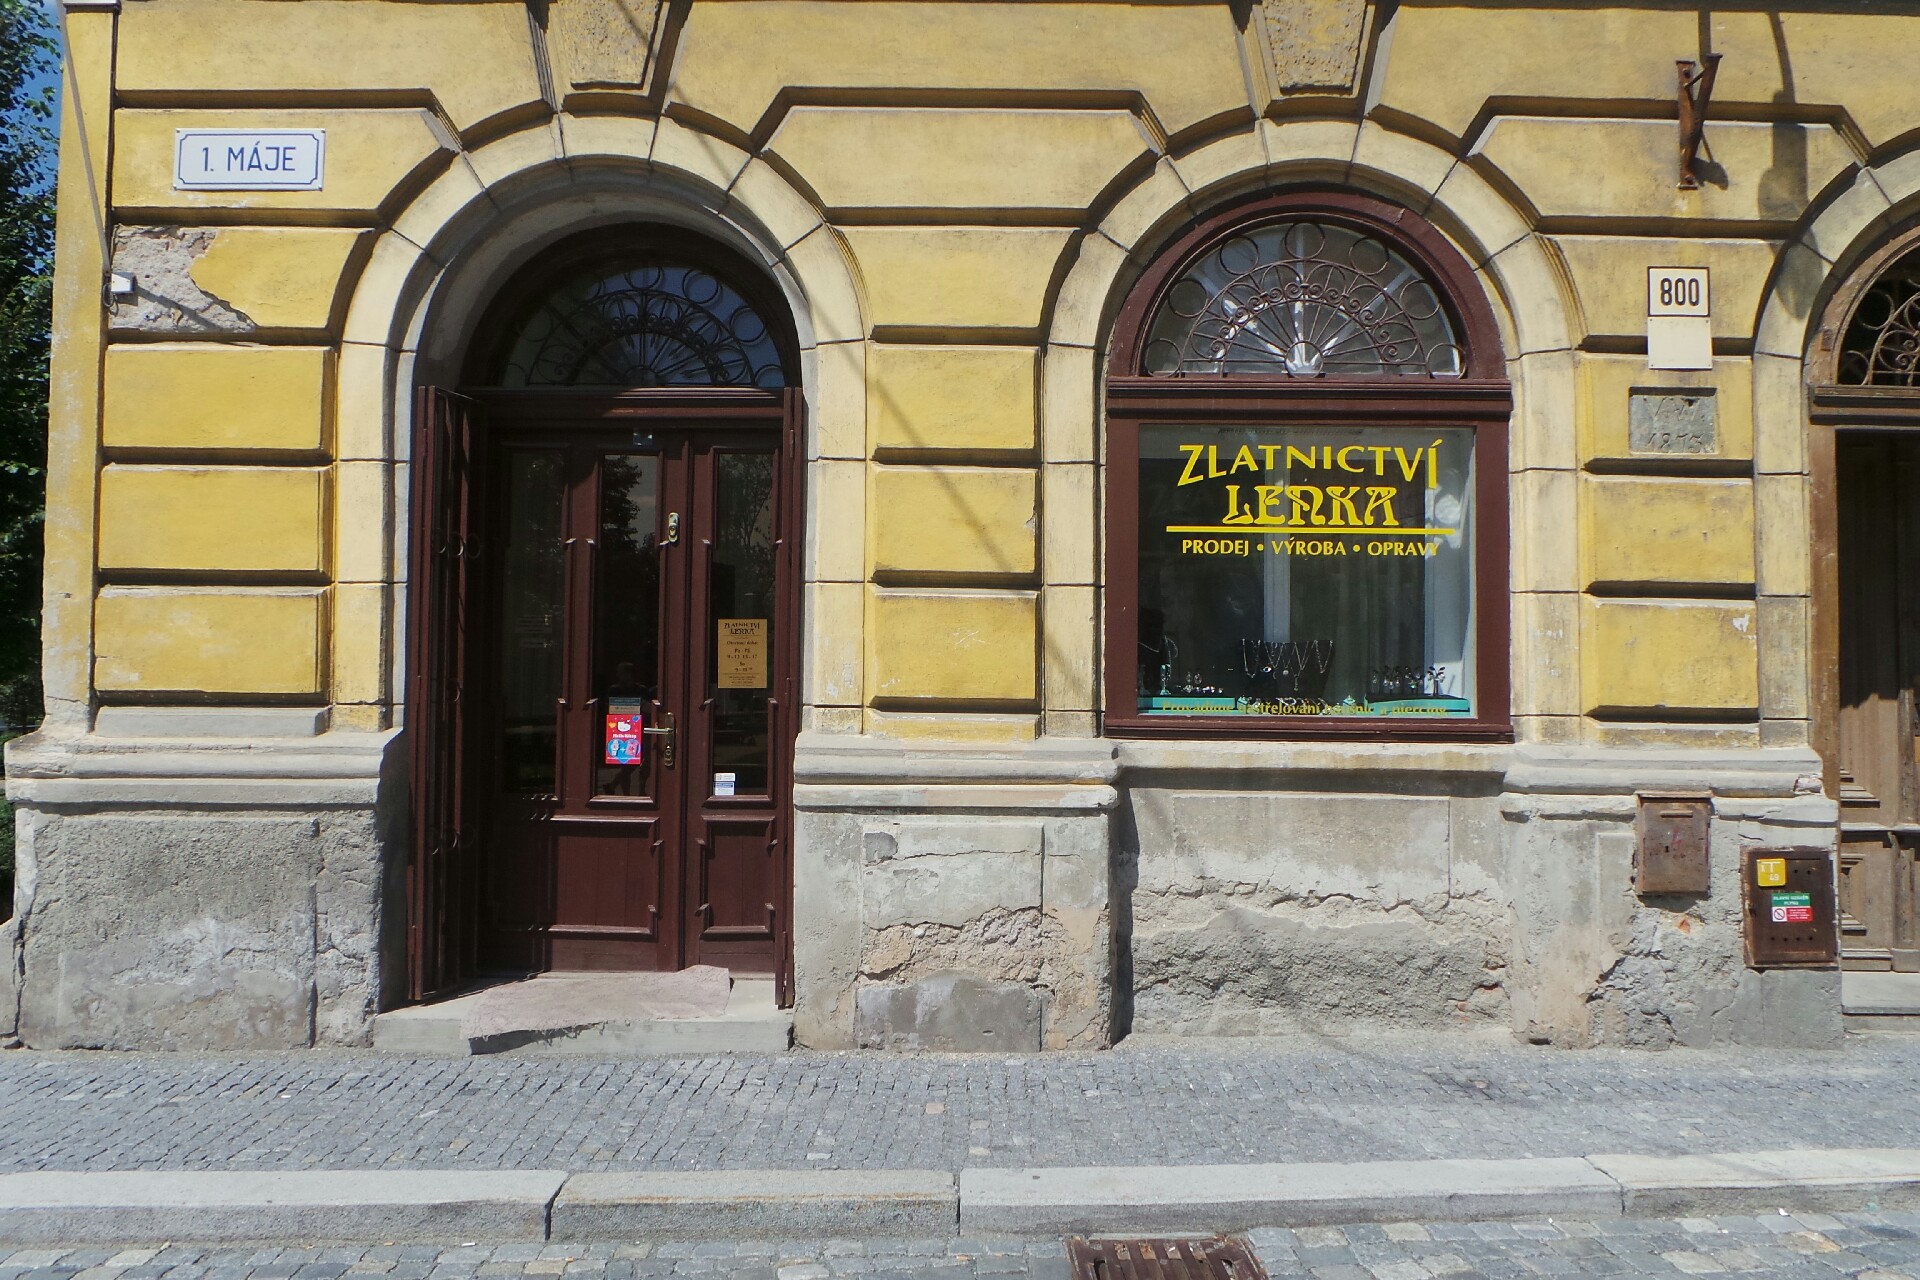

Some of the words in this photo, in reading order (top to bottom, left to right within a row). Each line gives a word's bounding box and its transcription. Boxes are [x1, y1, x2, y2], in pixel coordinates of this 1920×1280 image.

[202, 147, 214, 172] 1.
[227, 140, 297, 172] MÁJE
[1660, 277, 1700, 307] 800
[1177, 438, 1443, 489] ZLATNICTVÍ
[1222, 485, 1400, 526] LENKA
[1182, 539, 1249, 557] PRODEJ
[1271, 537, 1347, 556] VÝROBA
[1367, 541, 1440, 556] OPRAVY
